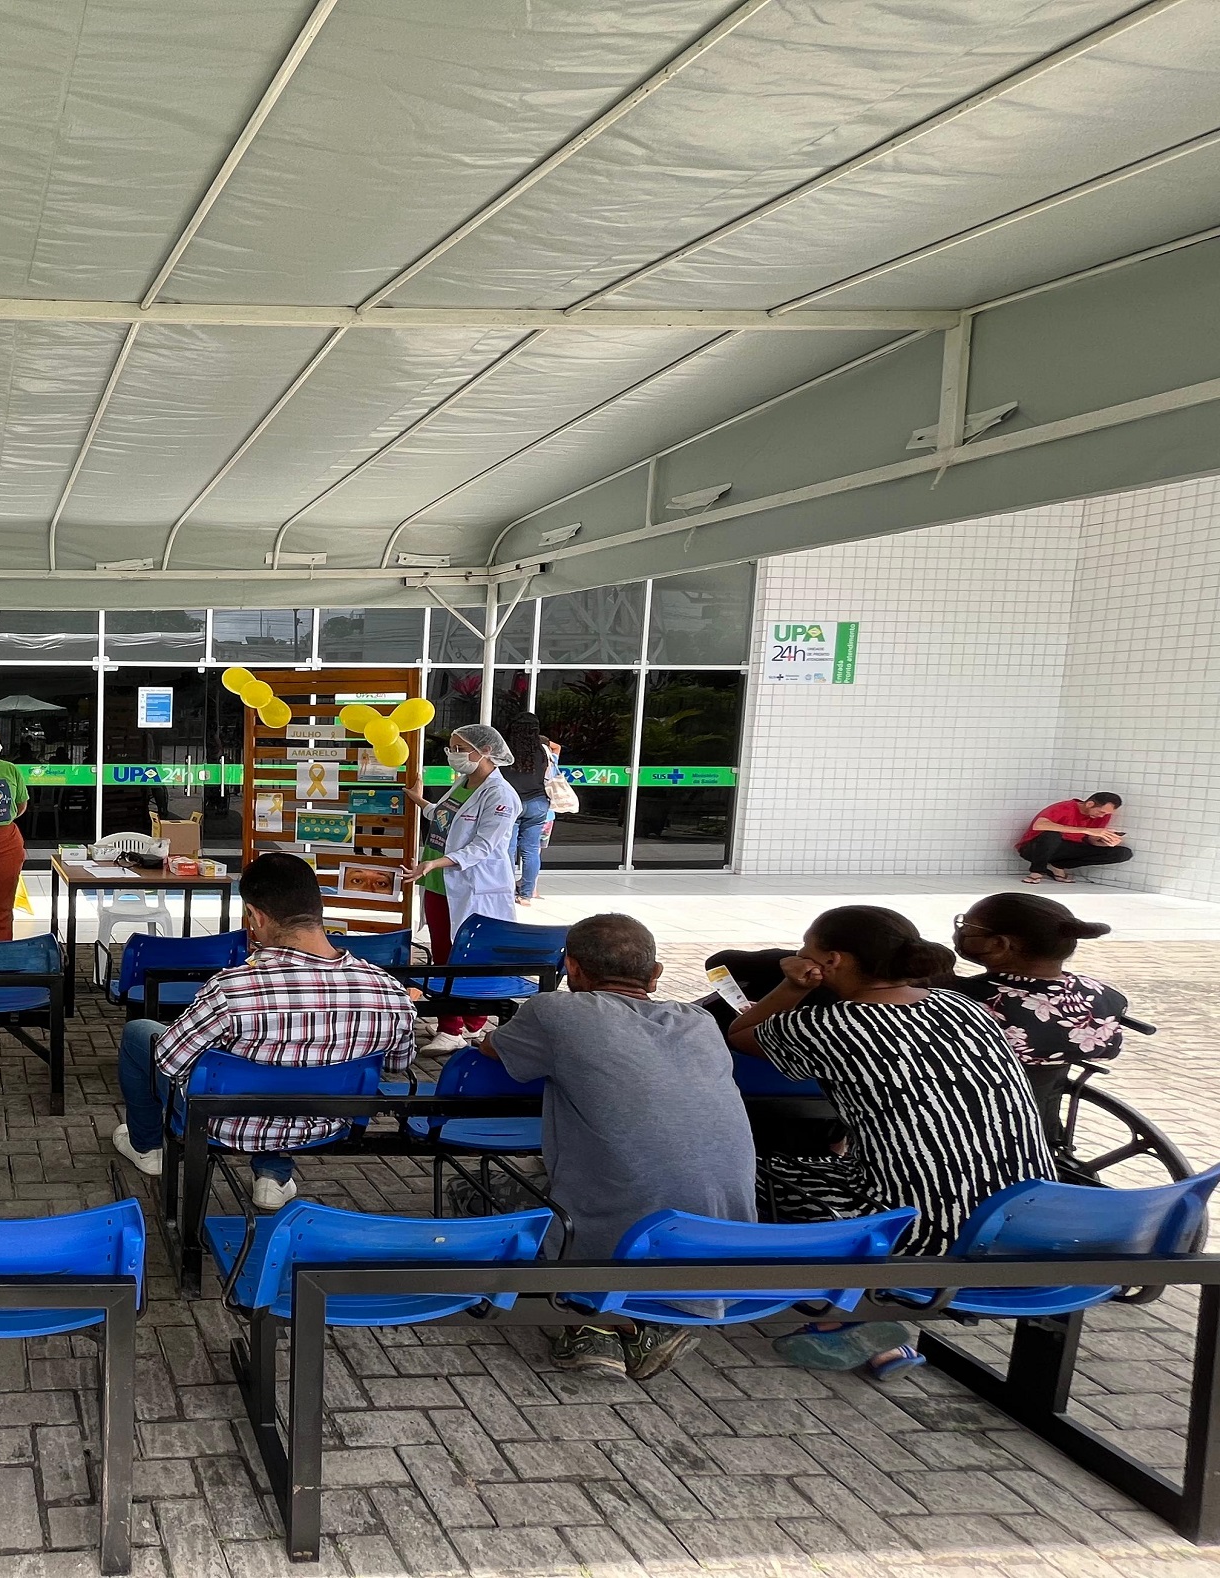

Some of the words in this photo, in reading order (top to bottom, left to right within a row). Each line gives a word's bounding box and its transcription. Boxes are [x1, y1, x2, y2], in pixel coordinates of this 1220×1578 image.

[774, 625, 826, 642] UPA
[771, 645, 806, 661] 24h
[291, 749, 338, 757] AMARELO
[113, 766, 162, 783] UPA
[161, 767, 194, 783] 24h
[559, 767, 587, 783] PA
[587, 768, 620, 784] 24h
